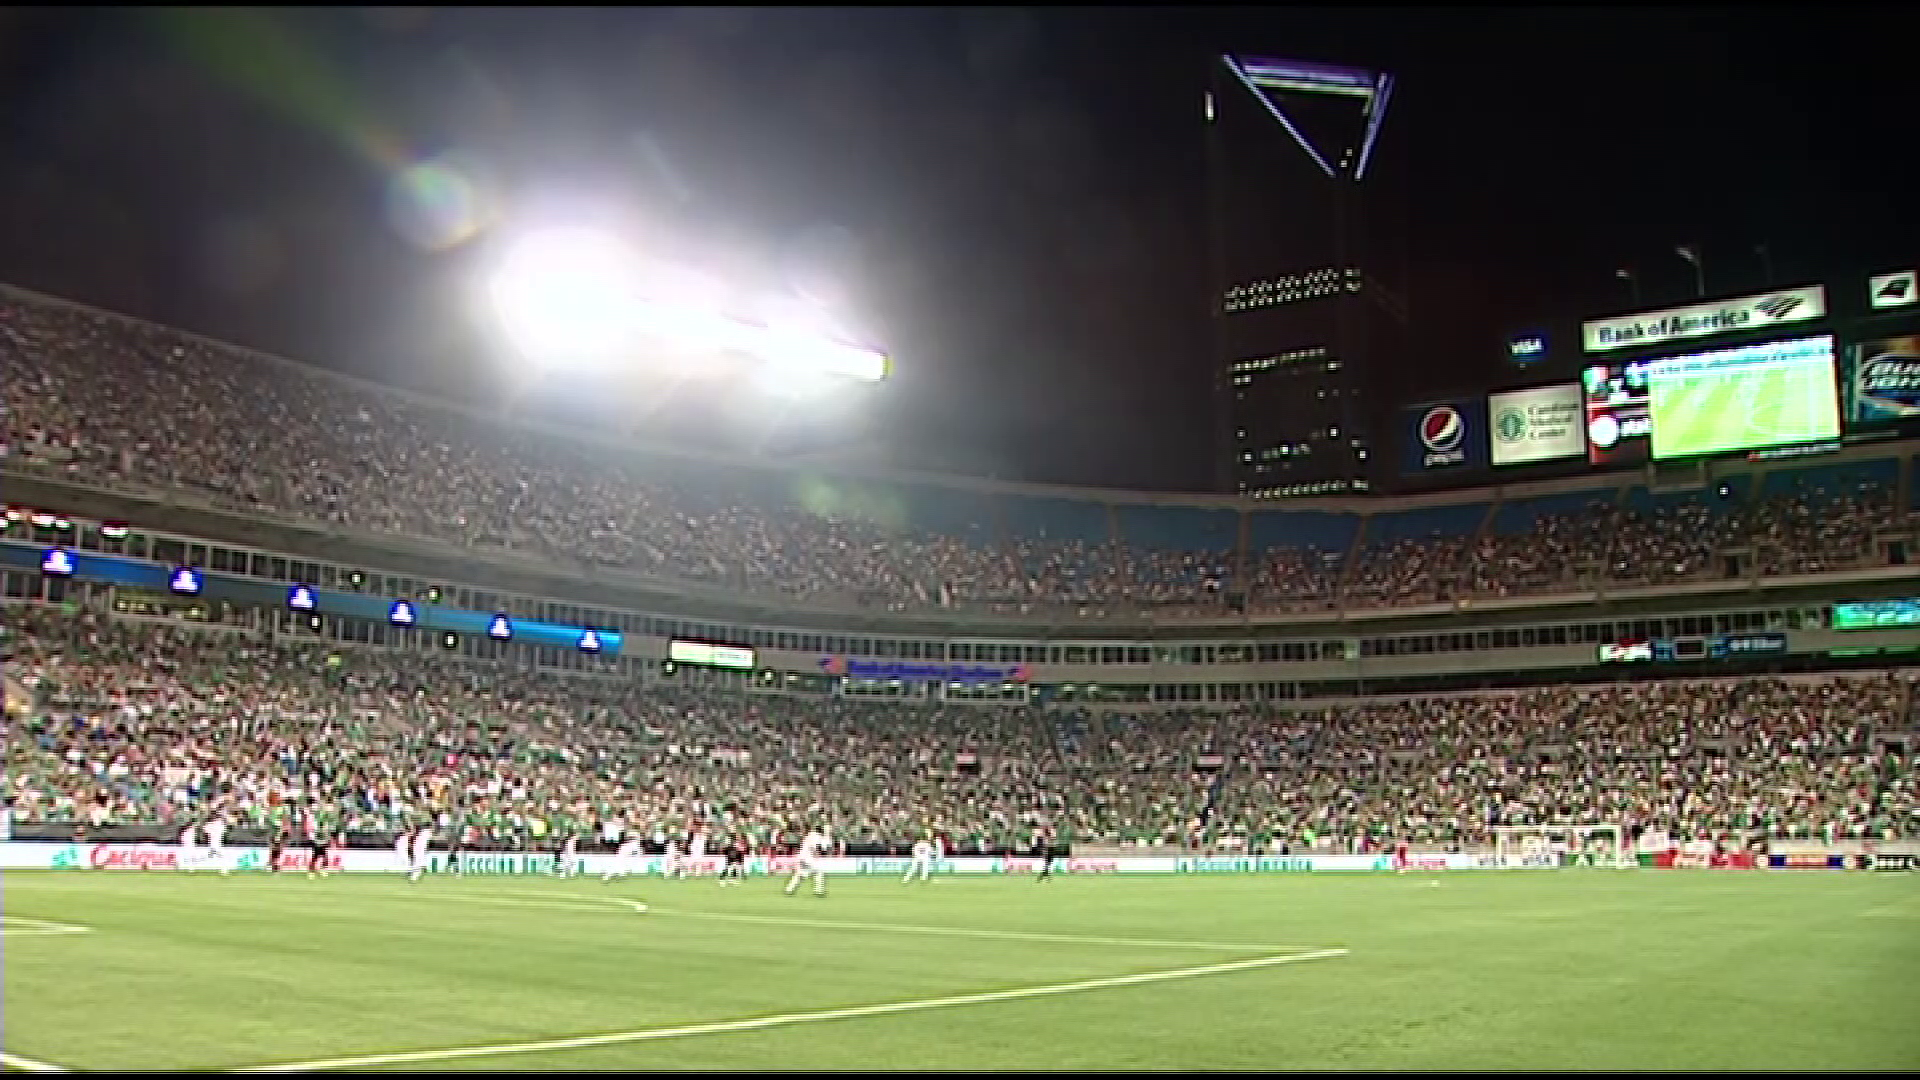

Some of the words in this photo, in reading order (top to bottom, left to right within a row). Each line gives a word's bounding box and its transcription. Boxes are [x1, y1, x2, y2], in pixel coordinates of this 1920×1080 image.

[1599, 322, 1644, 345] Bank
[1648, 316, 1668, 336] of
[1670, 308, 1751, 335] America
